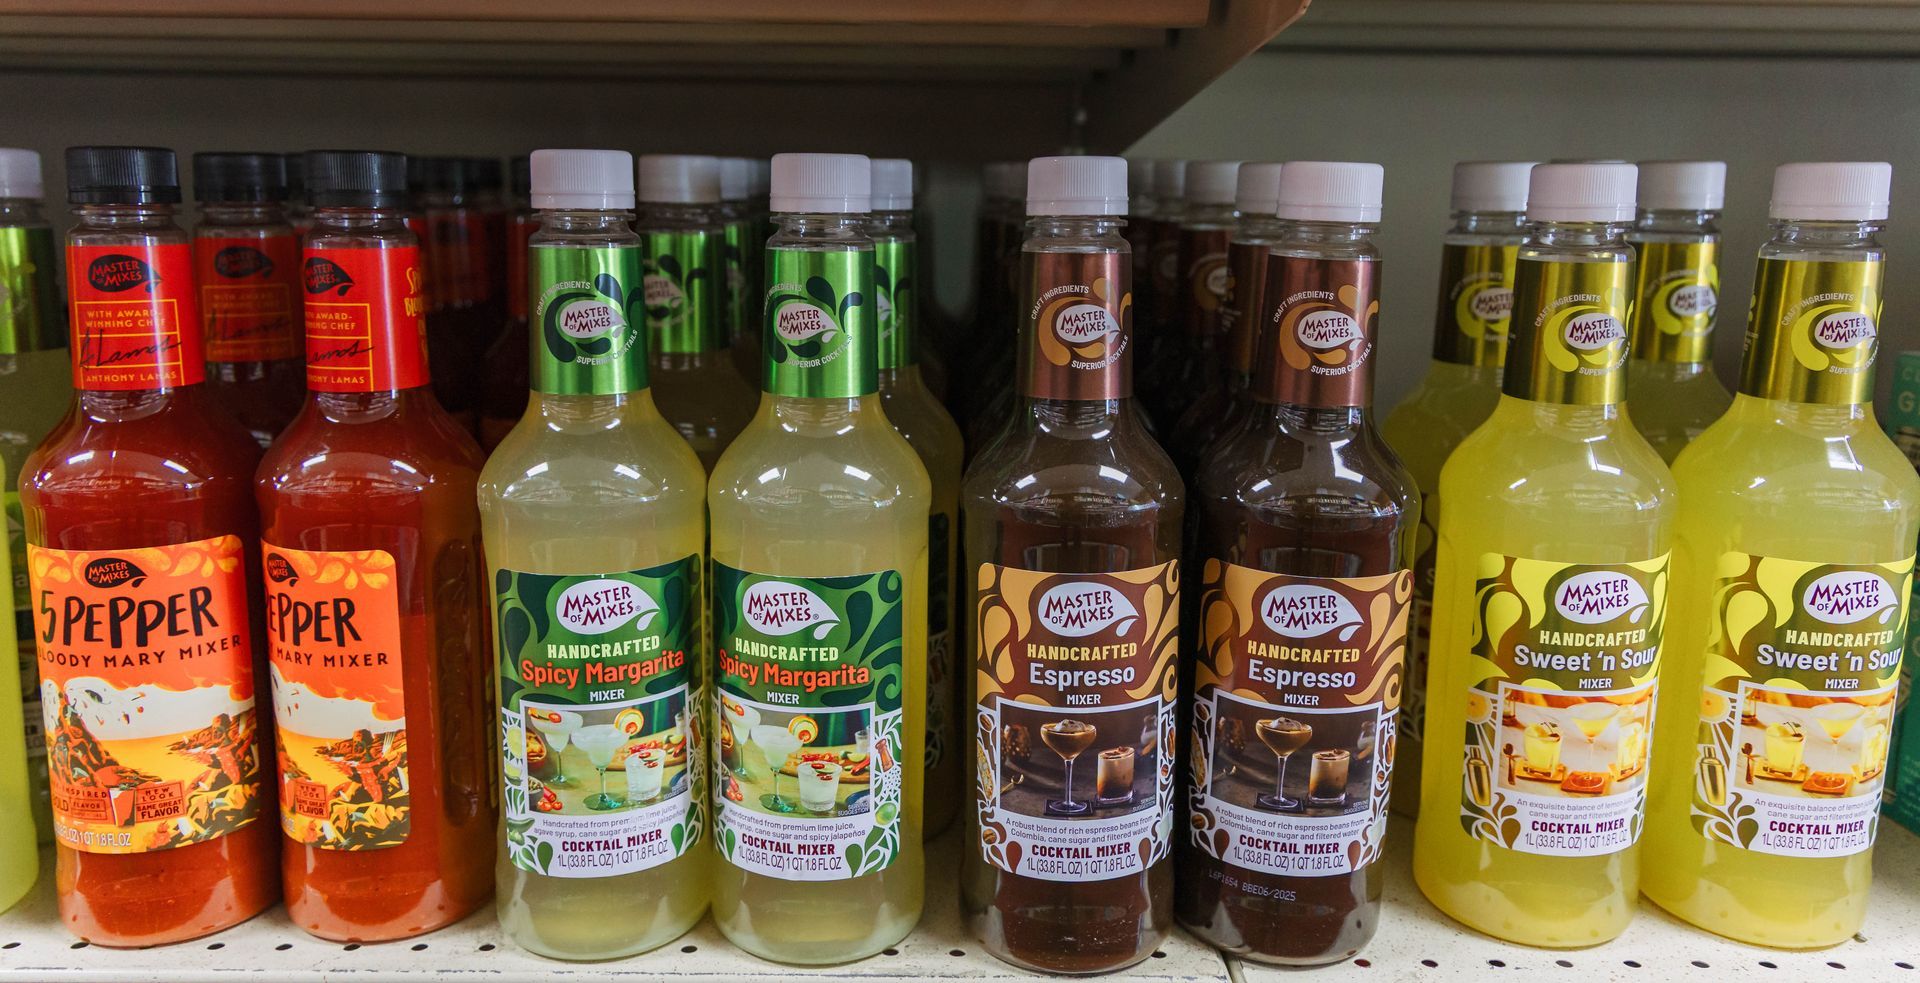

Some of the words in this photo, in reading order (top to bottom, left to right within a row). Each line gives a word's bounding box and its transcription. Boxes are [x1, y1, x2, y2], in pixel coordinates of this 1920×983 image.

[92, 261, 139, 280] MASTER
[105, 271, 142, 286] MIXES
[1031, 298, 1044, 320] CRAFT
[1043, 285, 1089, 300] INGREDIENTS
[1274, 301, 1287, 323] CRAFT
[1287, 291, 1334, 305] INGREDIENTS
[87, 310, 112, 318] WITH
[564, 307, 608, 326] MASTER
[779, 310, 819, 327] MASTER
[1061, 311, 1105, 330] MASTER
[86, 320, 133, 328] WINNING
[576, 317, 610, 332] MIXES
[788, 321, 820, 334] MIXES
[1072, 321, 1105, 336] MIXES
[1303, 318, 1348, 335] MASTER
[1314, 328, 1349, 342] MIXES
[1071, 360, 1105, 370] SUPERIOR
[1311, 365, 1346, 376] SUPERIOR
[86, 374, 135, 382] ANTHONY
[89, 562, 127, 579] MASTER
[99, 570, 129, 583] MIXES
[1561, 579, 1629, 606] MASTER
[1809, 579, 1879, 606] MASTER
[563, 586, 632, 618] MASTER
[747, 592, 809, 614] MASTER
[1044, 590, 1112, 618] MASTER
[1267, 595, 1337, 618] MASTER
[1569, 603, 1580, 612] OF
[1580, 593, 1629, 615] MIXES
[1817, 603, 1829, 611] OF
[1828, 594, 1879, 615] MIXES
[41, 590, 56, 644] 5
[63, 586, 219, 649] PEPPER
[268, 592, 362, 647] EPPER
[571, 615, 582, 623] OF
[582, 602, 634, 626] MIXES
[762, 608, 811, 627] MIXES
[1052, 616, 1062, 624] OF
[1062, 606, 1114, 629] MIXES
[1274, 616, 1285, 624] OF
[1284, 610, 1338, 630] MIXES
[548, 635, 660, 659] HANDCRAFTED
[1540, 629, 1646, 647] HANDCRAFTED
[1786, 630, 1893, 647] HANDCRAFTED
[105, 651, 165, 668] MARY
[180, 635, 242, 660] MIXER
[277, 647, 313, 666] MARY
[324, 653, 389, 667] MIXER
[736, 638, 838, 661] HANDCRAFTED
[1028, 643, 1137, 661] HANDCRAFTED
[1248, 640, 1360, 664] HANDCRAFTED
[1514, 645, 1591, 672] Sweet
[1621, 646, 1657, 670] Sour
[1757, 644, 1838, 672] Sweet
[1868, 647, 1901, 671] Sour
[522, 659, 579, 690] Spicy
[586, 650, 684, 685] Margarita
[720, 649, 758, 685] Spicy
[764, 663, 870, 693] Margarita
[1030, 662, 1135, 691] Espresso
[1249, 659, 1356, 691] Espresso
[1579, 678, 1612, 689] MIXER
[1825, 678, 1859, 689] MIXER
[590, 689, 624, 702] MIXER
[767, 691, 799, 704] MIXER
[1067, 694, 1101, 705] MIXER
[1284, 693, 1319, 706] MIXER
[142, 792, 174, 801] LOOK
[145, 787, 170, 795] NEW
[141, 806, 180, 819] FLAVOR
[159, 800, 181, 808] GREAT
[765, 821, 781, 829] from
[783, 824, 816, 832] premium
[1012, 821, 1034, 830] robust
[1037, 825, 1057, 833] blend
[1085, 825, 1118, 834] espresso
[1120, 820, 1139, 830] beans
[1532, 821, 1592, 834] COCKTAIL
[1596, 818, 1625, 833] MIXER
[1770, 820, 1832, 835] COCKTAIL
[1836, 820, 1864, 834] MIXER
[562, 839, 623, 852] COCKTAIL
[628, 829, 662, 848] MIXER
[742, 833, 793, 854] COCKTAIL
[798, 843, 835, 855] MIXER
[772, 831, 791, 840] sugar
[794, 832, 811, 840] and
[810, 832, 829, 841] spicy
[1011, 828, 1046, 842] Colombia,
[1069, 837, 1090, 845] sugar
[1092, 835, 1105, 843] and
[1107, 830, 1131, 841] filtered
[1239, 834, 1300, 855] COCKTAIL
[1304, 842, 1339, 855] MIXER
[1032, 844, 1092, 858] COCKTAIL
[1097, 842, 1130, 857] MIXER
[1027, 857, 1035, 870] 1L
[1037, 859, 1055, 875] (33.8
[1057, 861, 1066, 874] FL
[1068, 861, 1082, 878] OZ)
[1085, 861, 1088, 874] 1
[1091, 860, 1102, 874] QT
[1104, 859, 1114, 872] 1.8
[1116, 857, 1124, 870] FL
[1126, 854, 1135, 868] OZ
